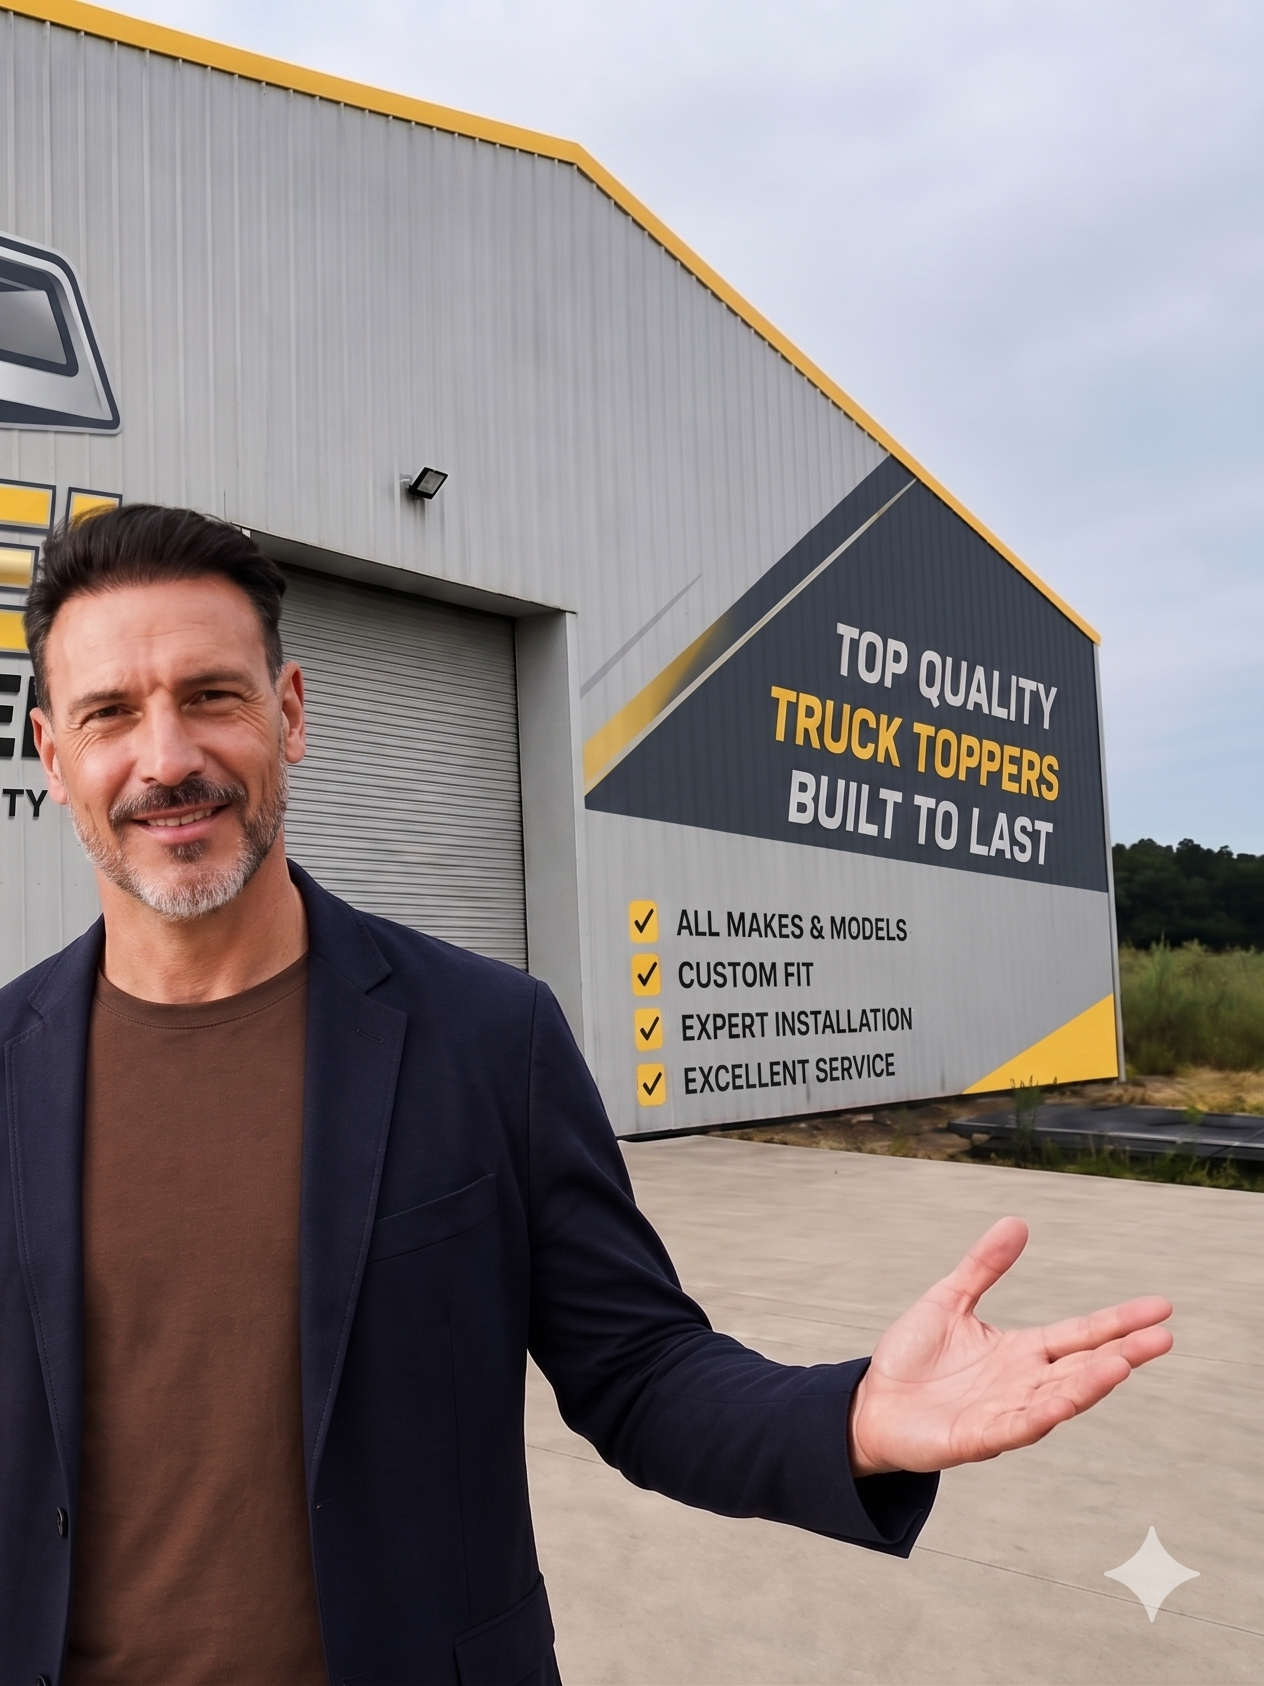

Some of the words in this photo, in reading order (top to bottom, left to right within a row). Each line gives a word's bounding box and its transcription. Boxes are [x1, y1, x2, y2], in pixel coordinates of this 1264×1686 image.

[837, 622, 908, 689] TOP
[919, 650, 1057, 730] QUALITY
[770, 685, 903, 768] TRUCK
[913, 722, 1059, 801] TOPPERS
[788, 769, 903, 839] BUILT
[913, 794, 958, 851] TO
[969, 807, 1054, 865] LAST
[676, 909, 720, 937] ALL
[726, 911, 804, 940] MAKES
[809, 915, 825, 940] &
[830, 916, 908, 941] MODELS
[678, 961, 778, 989] CUSTOM
[784, 961, 814, 987] FIT
[681, 1011, 769, 1042] EXPERT
[775, 1007, 913, 1037] INSTALLATION
[684, 1058, 810, 1095] EXCELLENT
[815, 1052, 896, 1084] SERVICE
